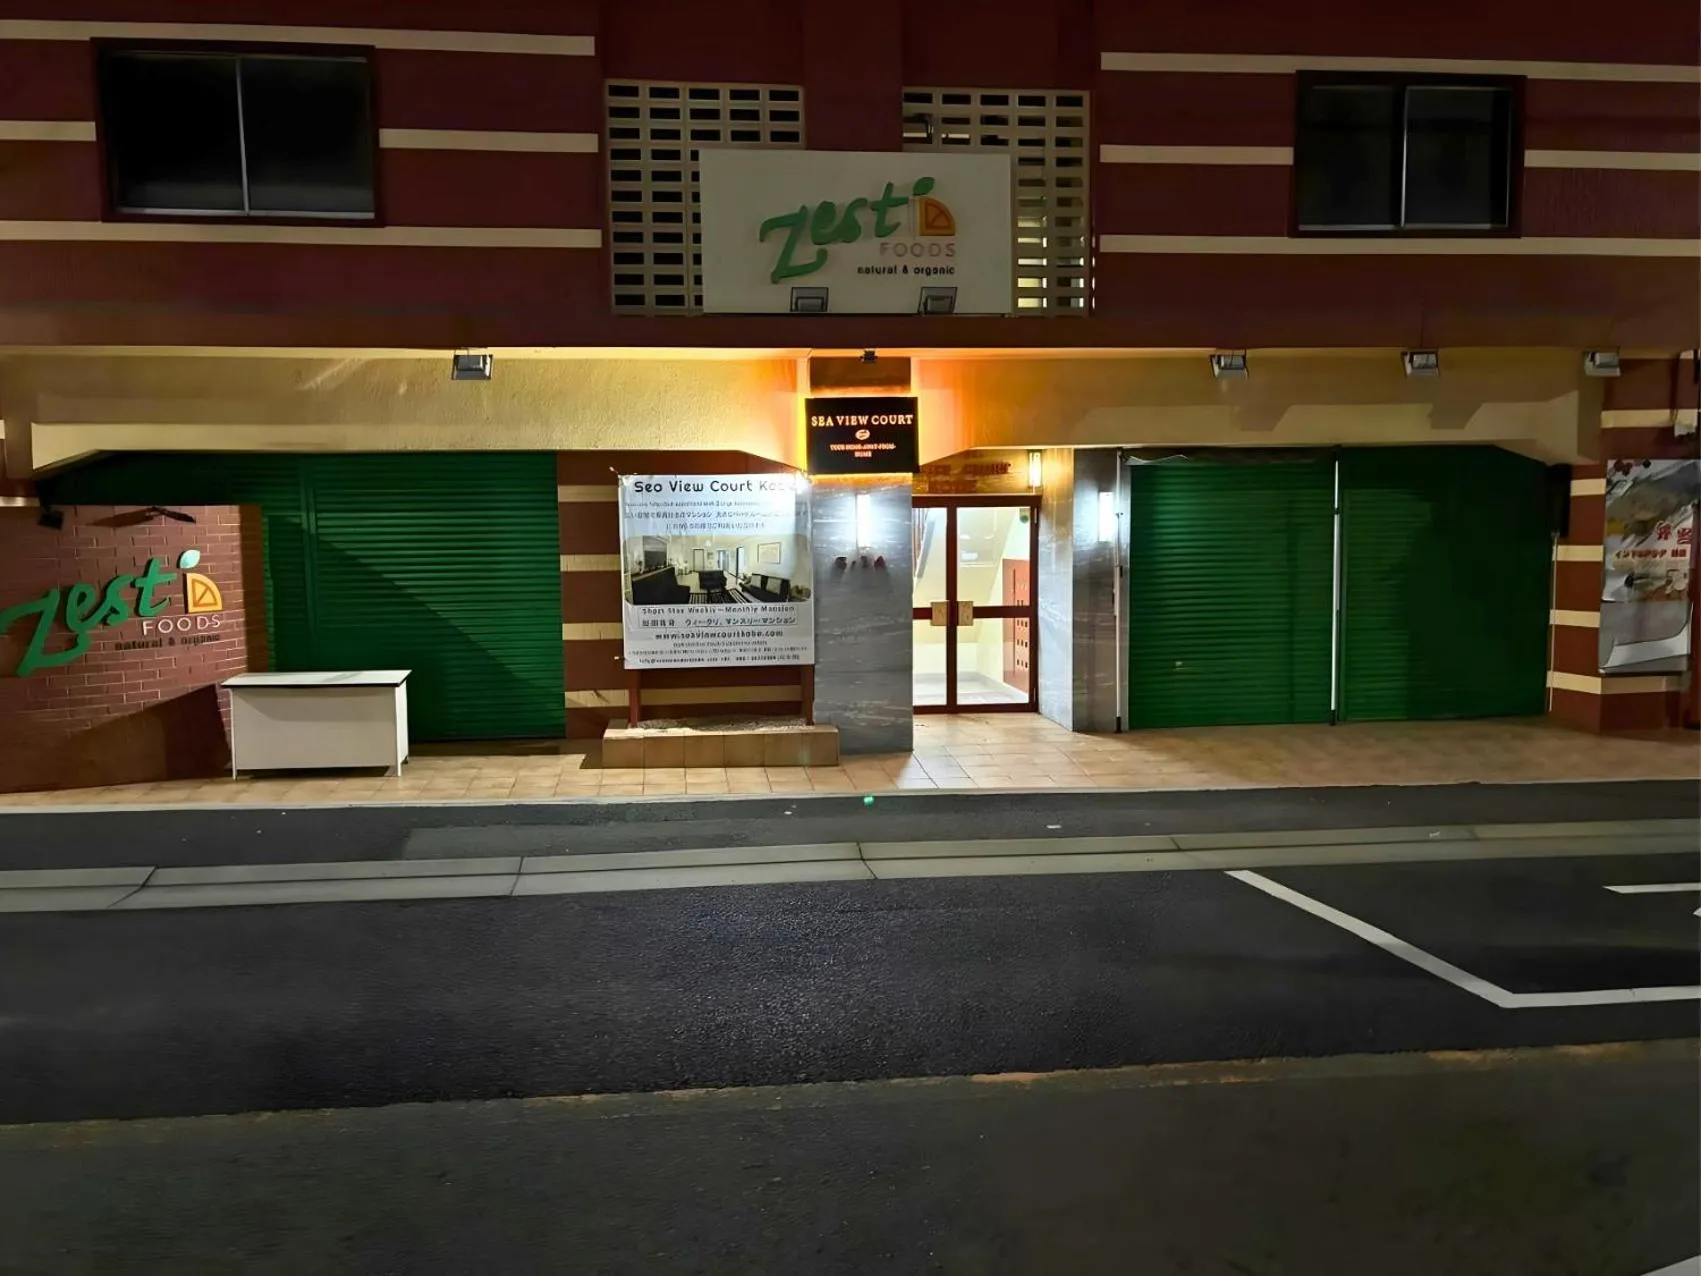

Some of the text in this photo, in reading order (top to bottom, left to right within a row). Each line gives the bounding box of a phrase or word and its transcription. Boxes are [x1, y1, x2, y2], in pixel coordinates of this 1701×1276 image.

[880, 242, 956, 258] FOODS
[857, 264, 955, 276] natural & organic
[811, 414, 914, 427] SEA VIEW COURT
[669, 480, 704, 492] View
[710, 480, 753, 492] Court
[142, 614, 221, 636] FOODS
[114, 639, 163, 651] natural
